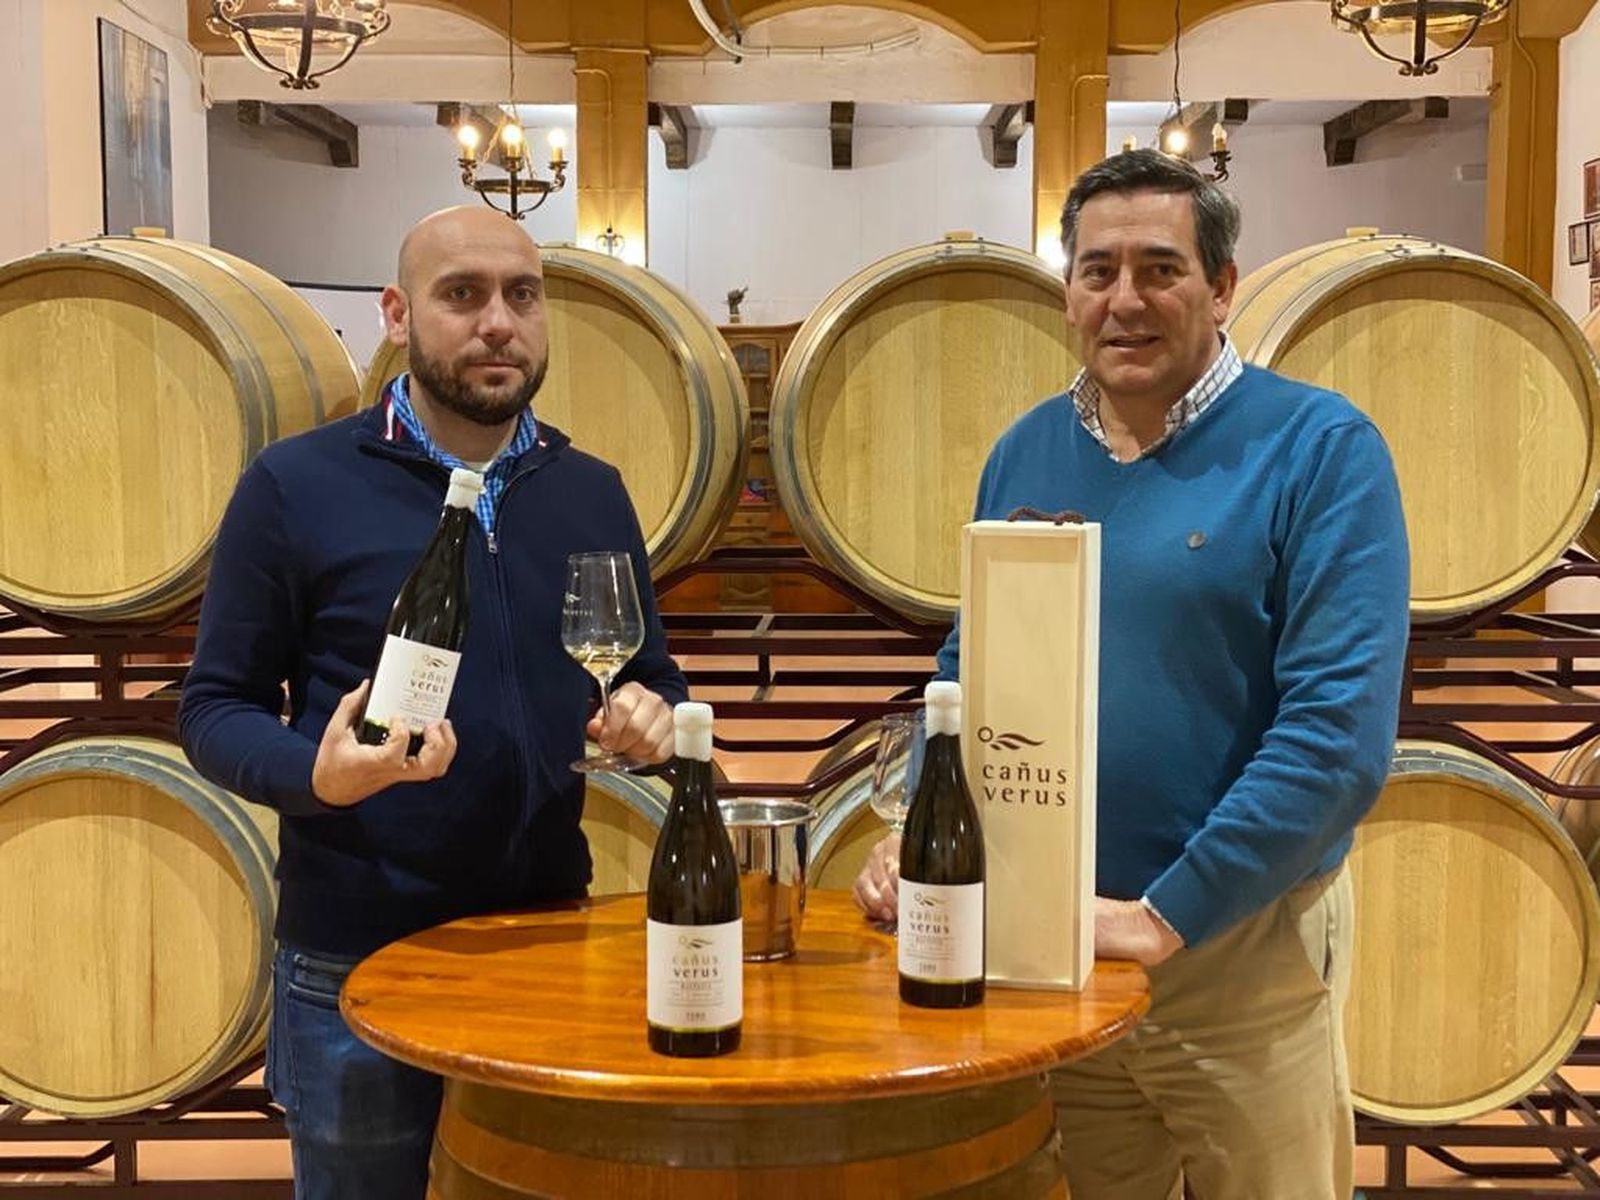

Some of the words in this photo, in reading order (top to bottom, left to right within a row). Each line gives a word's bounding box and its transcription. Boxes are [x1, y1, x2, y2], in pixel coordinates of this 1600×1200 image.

[410, 678, 444, 693] verus
[983, 762, 1067, 784] cañus
[983, 785, 1067, 807] verus
[910, 922, 949, 934] verus
[673, 967, 719, 978] verus
